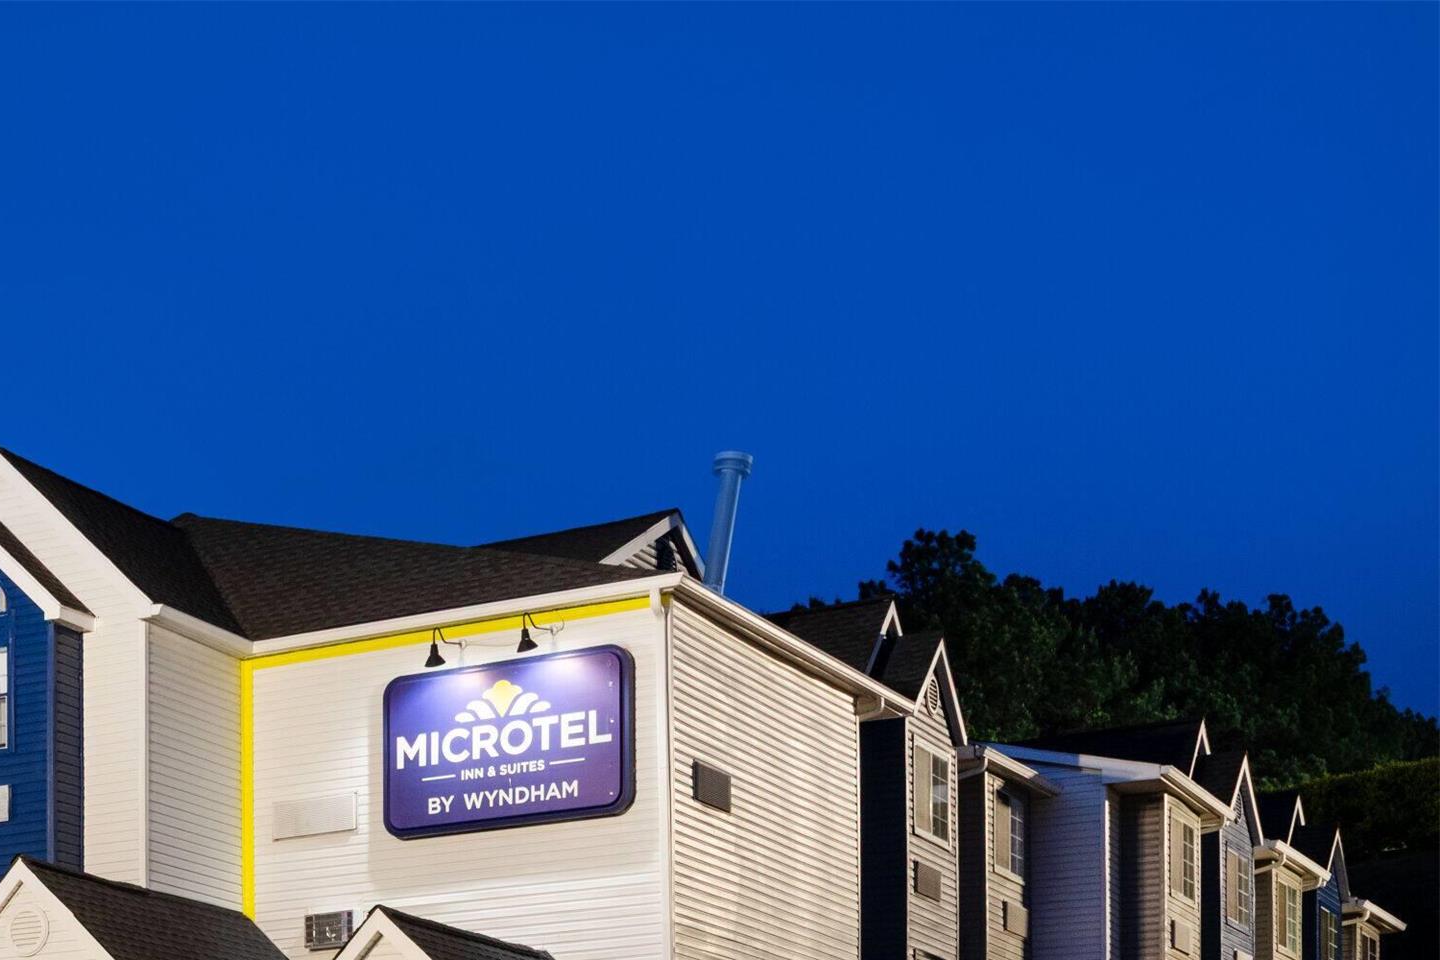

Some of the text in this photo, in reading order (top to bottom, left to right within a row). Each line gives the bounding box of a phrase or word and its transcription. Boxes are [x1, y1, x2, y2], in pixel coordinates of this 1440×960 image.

[396, 709, 612, 770] MICROTEL
[460, 759, 546, 781] INN & SUITES
[428, 779, 579, 815] BY WYNDHAM
